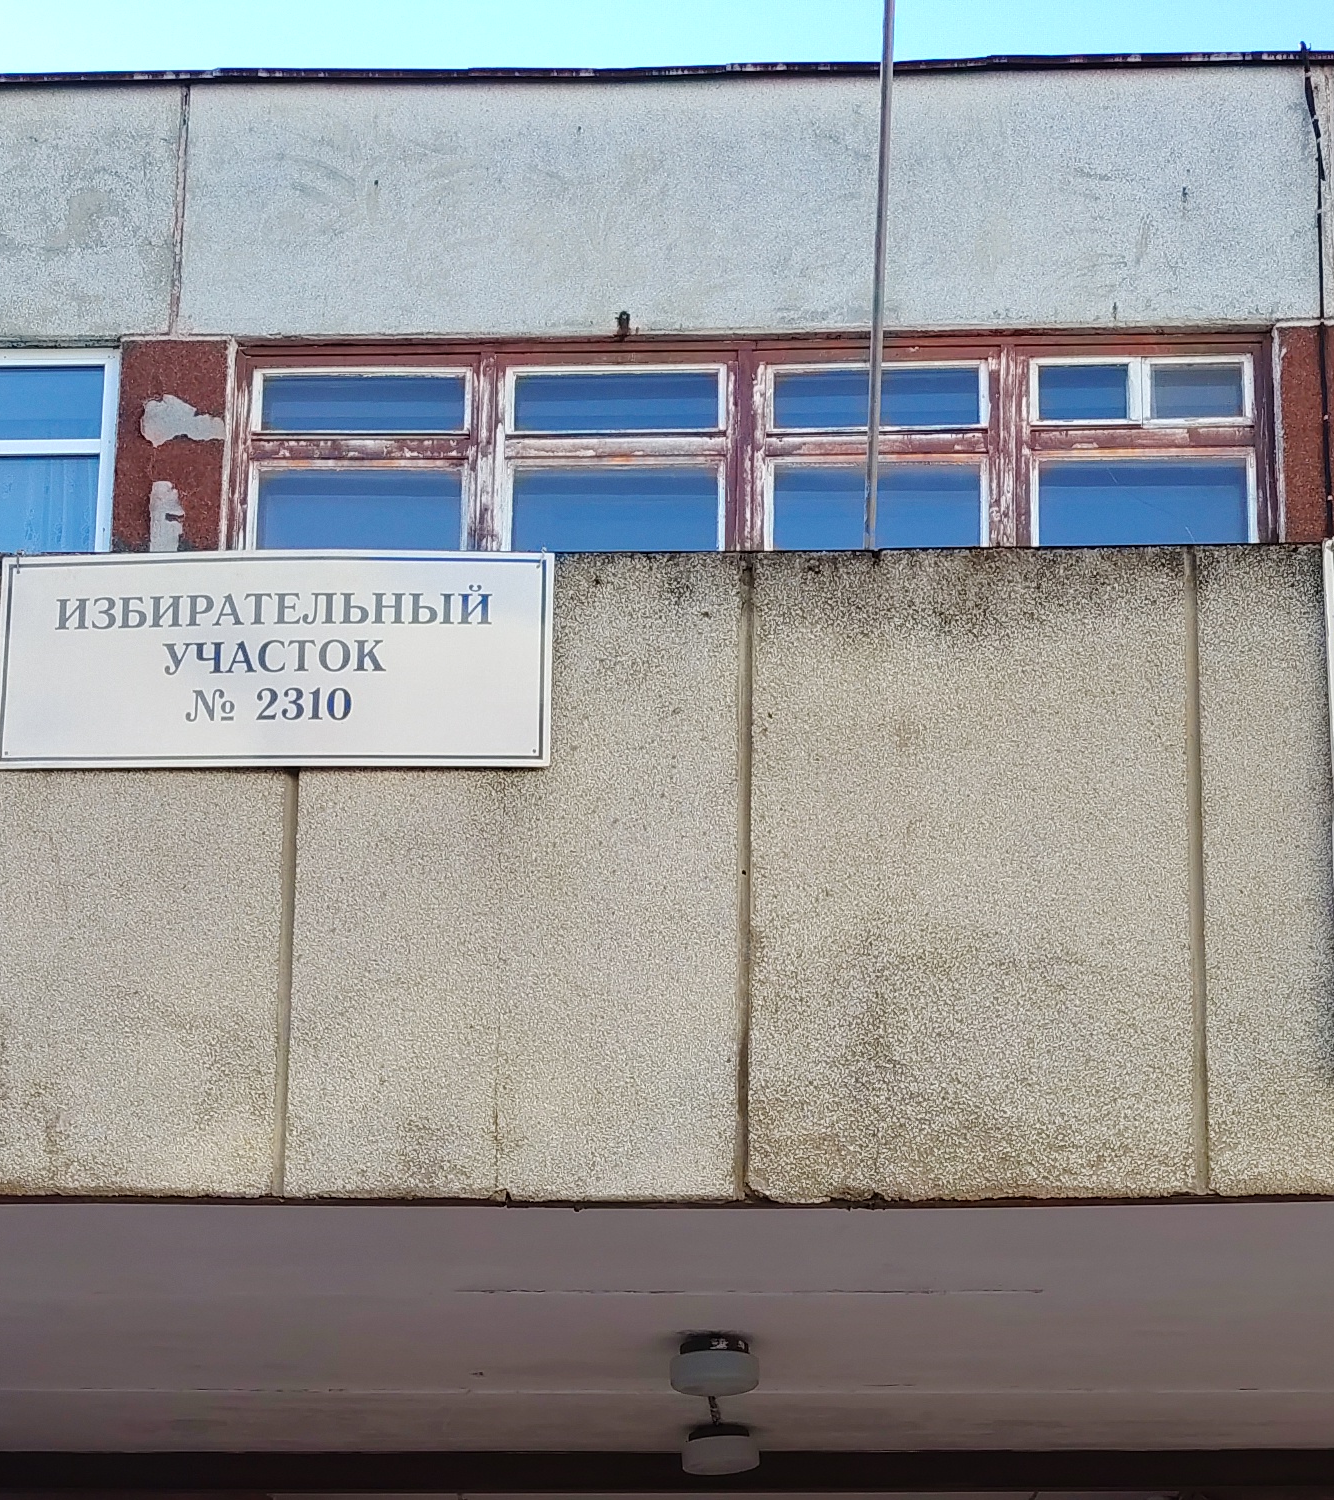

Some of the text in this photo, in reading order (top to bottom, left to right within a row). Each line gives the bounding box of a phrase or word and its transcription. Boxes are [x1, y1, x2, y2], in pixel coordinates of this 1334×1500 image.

[55, 584, 493, 631] ИЗБИРАТЕЛЬНЫЙ
[162, 639, 387, 676] УЧАСТОК
[185, 686, 354, 722] № 2310
